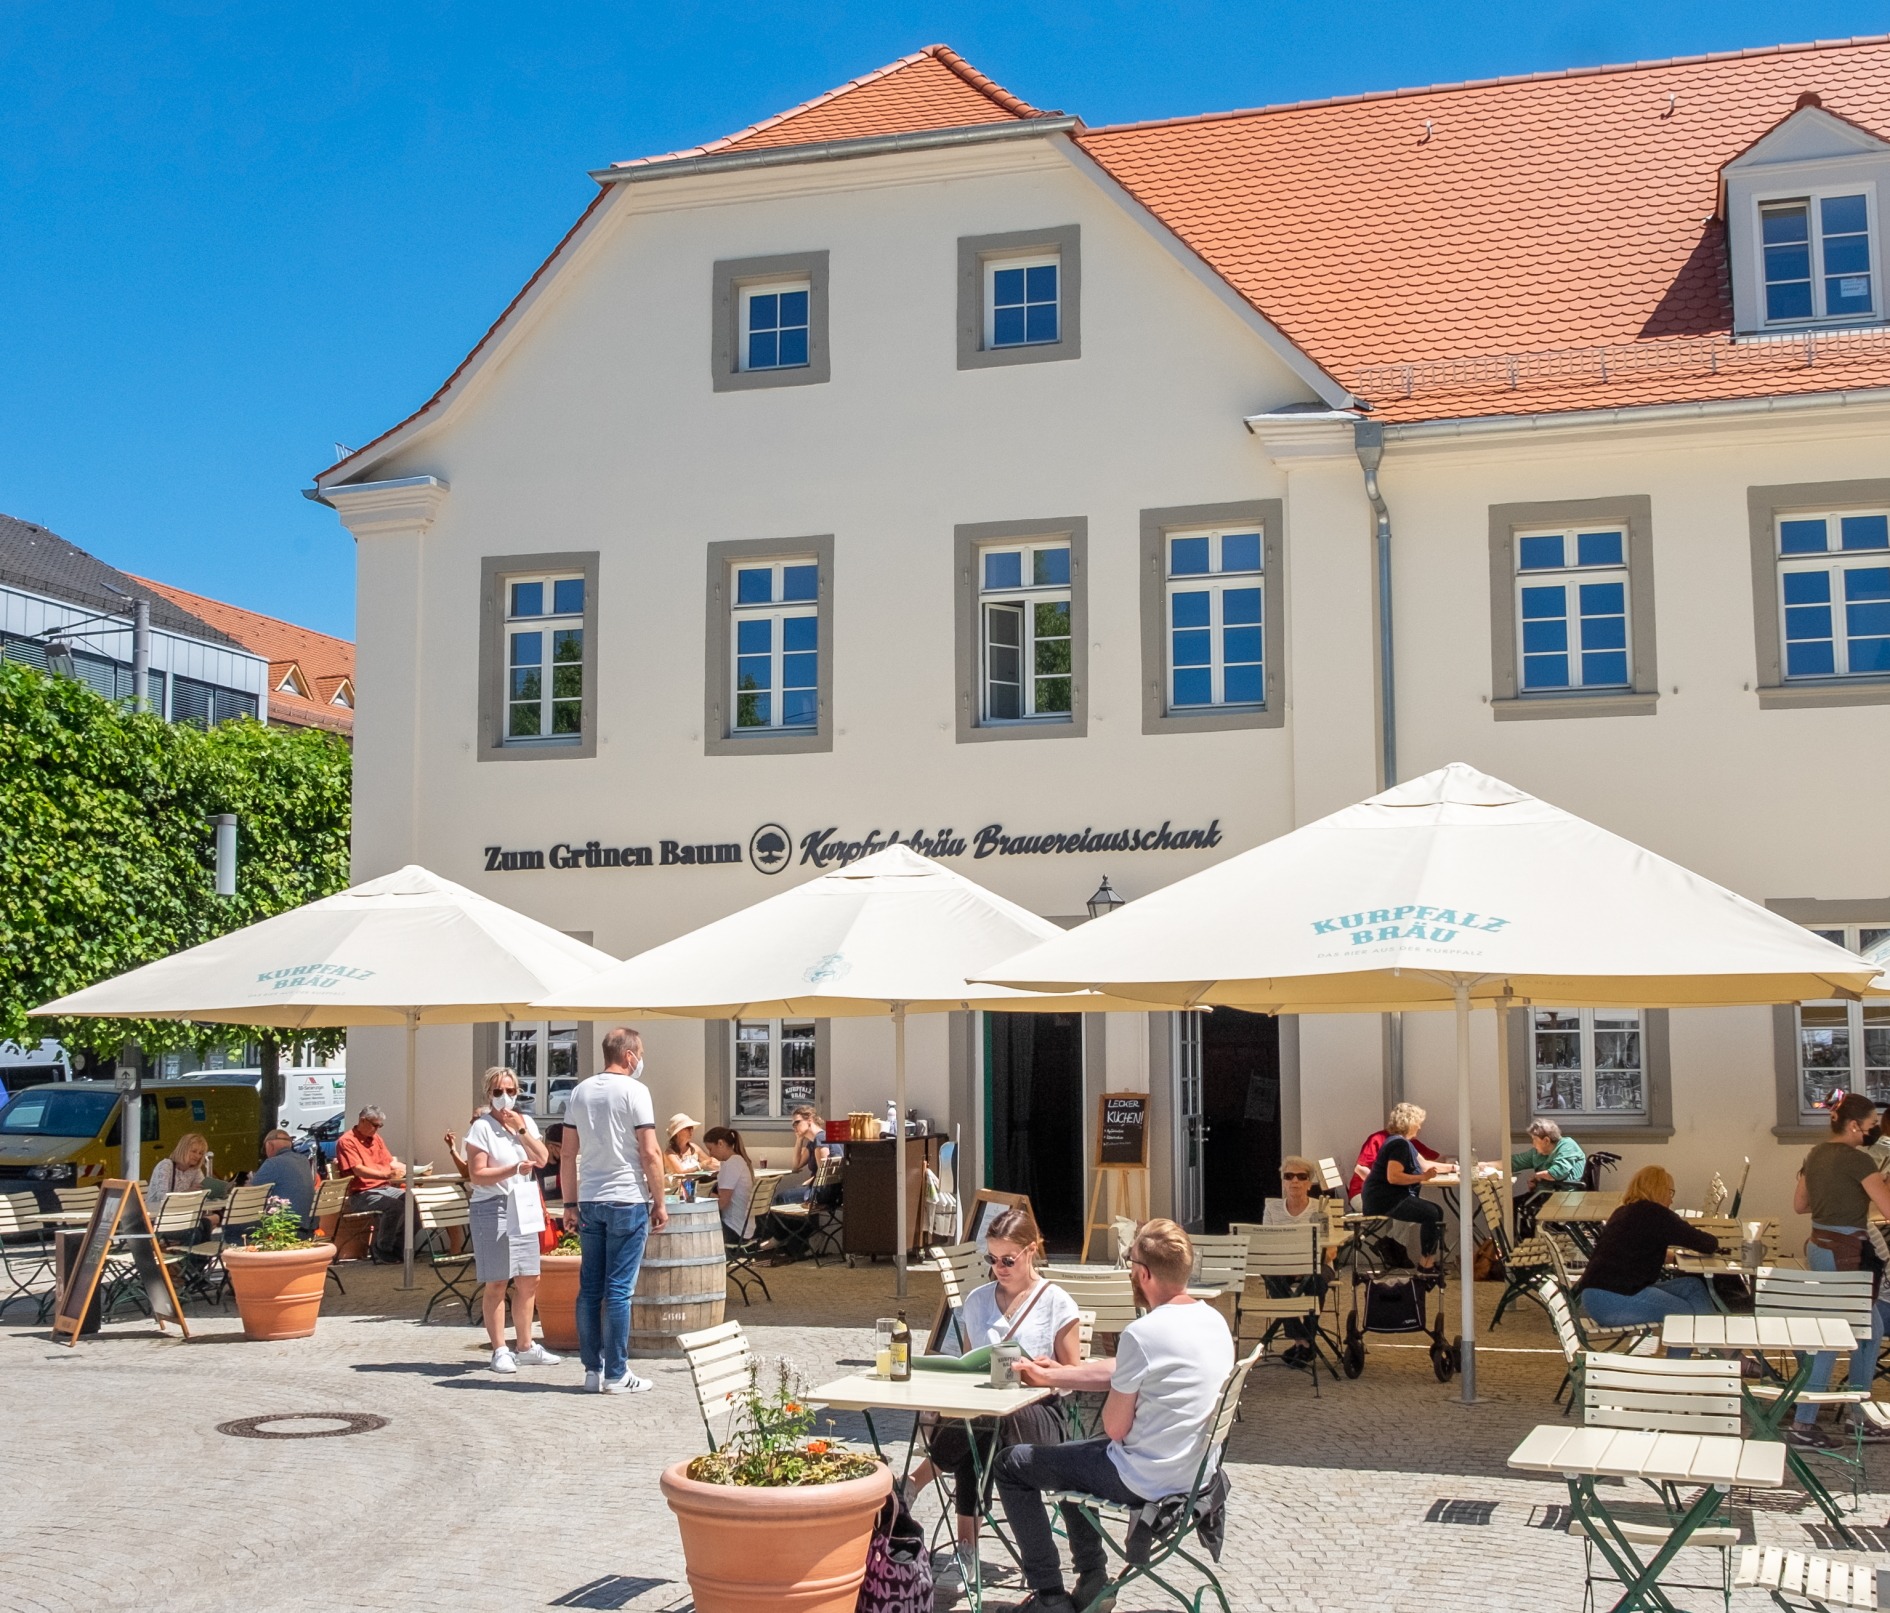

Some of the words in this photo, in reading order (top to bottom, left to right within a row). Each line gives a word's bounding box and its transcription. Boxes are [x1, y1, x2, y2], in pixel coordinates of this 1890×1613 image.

[484, 847, 545, 871] Zum
[549, 841, 653, 869] Grünen
[659, 840, 743, 866] Baum
[799, 827, 968, 869] Kurpfalbräu
[972, 819, 1223, 859] Brauereiausschank
[1310, 905, 1512, 935] KURPFALZ
[1350, 921, 1460, 945] BRÄU
[256, 963, 377, 982] KURPFALZ
[272, 974, 341, 990] BRÄU
[1107, 1099, 1140, 1108] LECKER
[1106, 1110, 1145, 1125] KUCHEN!
